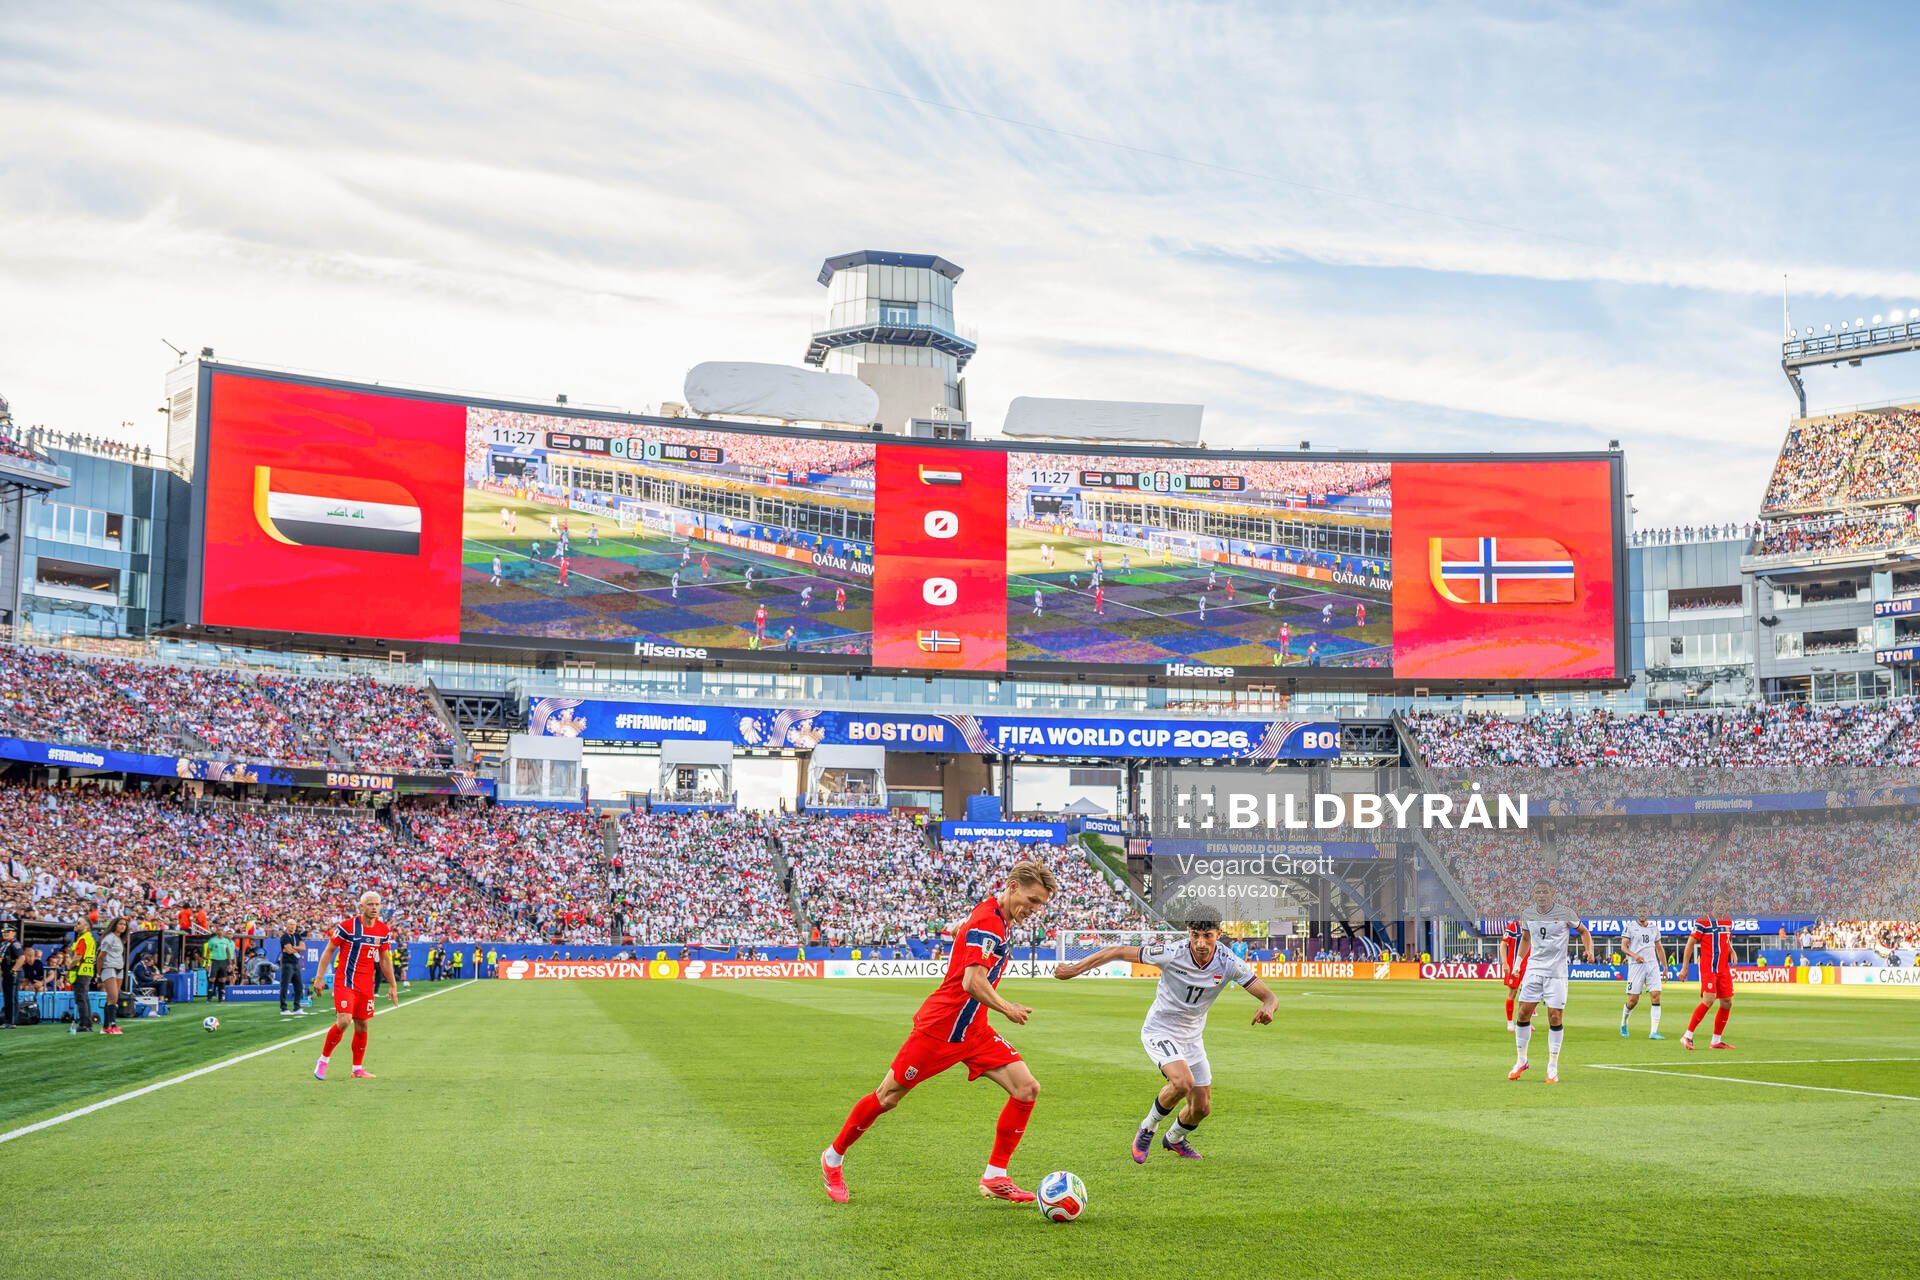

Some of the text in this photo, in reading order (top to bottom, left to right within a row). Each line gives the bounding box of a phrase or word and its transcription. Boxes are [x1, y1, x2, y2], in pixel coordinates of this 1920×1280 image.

[492, 430, 535, 444] 11:27
[585, 438, 687, 458] IRQ 0 0 NOR
[1031, 471, 1070, 483] 11:27
[1116, 474, 1211, 488] IRQ 0 0 NOR
[812, 552, 847, 570] QATAR
[1332, 570, 1366, 586] QATAR
[634, 642, 708, 660] Hisense
[1166, 664, 1235, 678] Hisense
[615, 714, 707, 735] #FIFAWorldCup
[848, 722, 944, 742] BOSTON
[998, 726, 1248, 749] FIFA WORLD CUP 2026
[48, 748, 104, 768] #FIFAWorldCup
[327, 772, 393, 790] BOSTON
[954, 828, 1053, 837] FIFA WORLD CUP 2026
[1085, 822, 1120, 833] BOSTON
[1206, 843, 1322, 854] FIFA WORLD CUP 2026
[1540, 926, 1547, 940] 9
[1588, 918, 1620, 932] FIFA
[1678, 918, 1695, 932] CU
[1642, 934, 1650, 944] 18
[534, 962, 644, 980] ExpressVPN
[711, 962, 818, 979] ExpressVPN
[1262, 962, 1298, 978] DEPOT
[1300, 963, 1354, 977] DELIVERS
[1422, 964, 1478, 980] QATAR
[1570, 968, 1610, 979] American
[1730, 968, 1790, 983] ExpressVPN
[1185, 986, 1205, 1004] 17
[1157, 1040, 1178, 1057] 17
